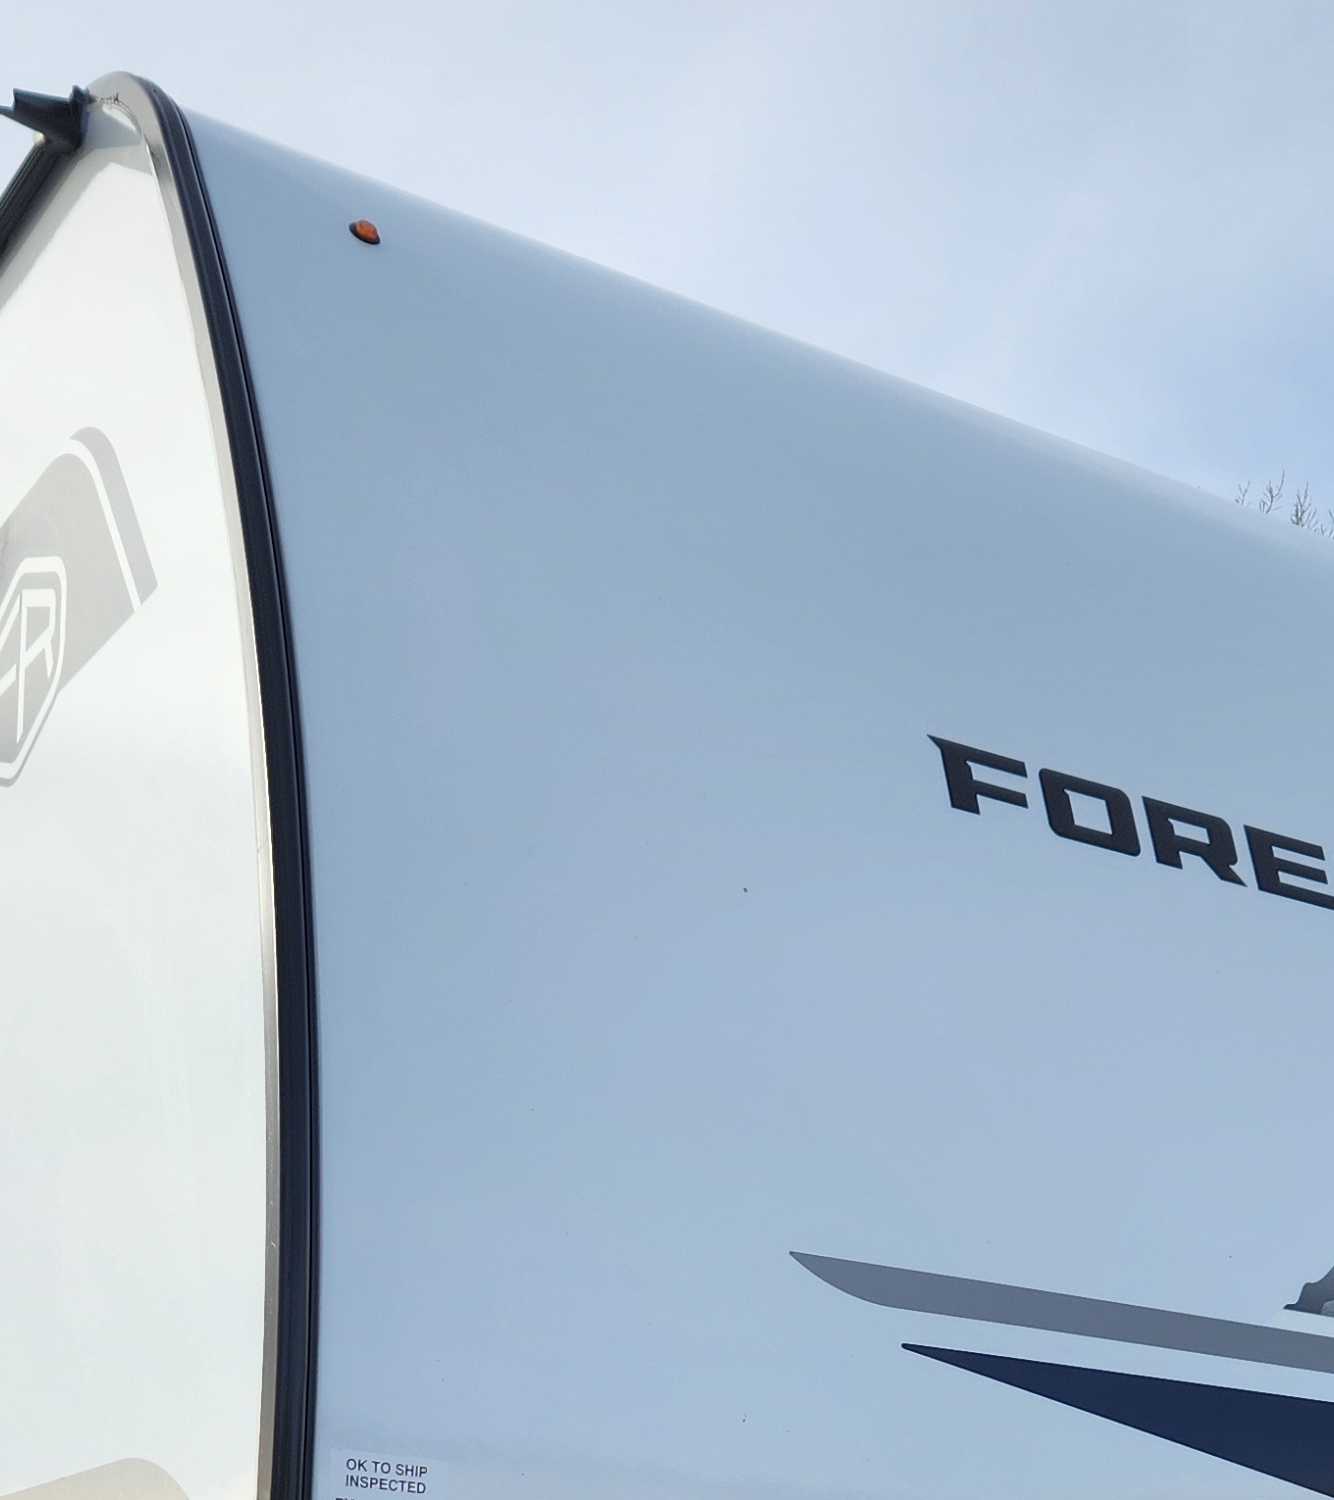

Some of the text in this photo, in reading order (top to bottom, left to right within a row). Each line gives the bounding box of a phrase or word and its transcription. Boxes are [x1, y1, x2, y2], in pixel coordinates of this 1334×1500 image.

[346, 1459, 428, 1478] OK TO SHIP
[345, 1474, 427, 1494] INSPECTED
